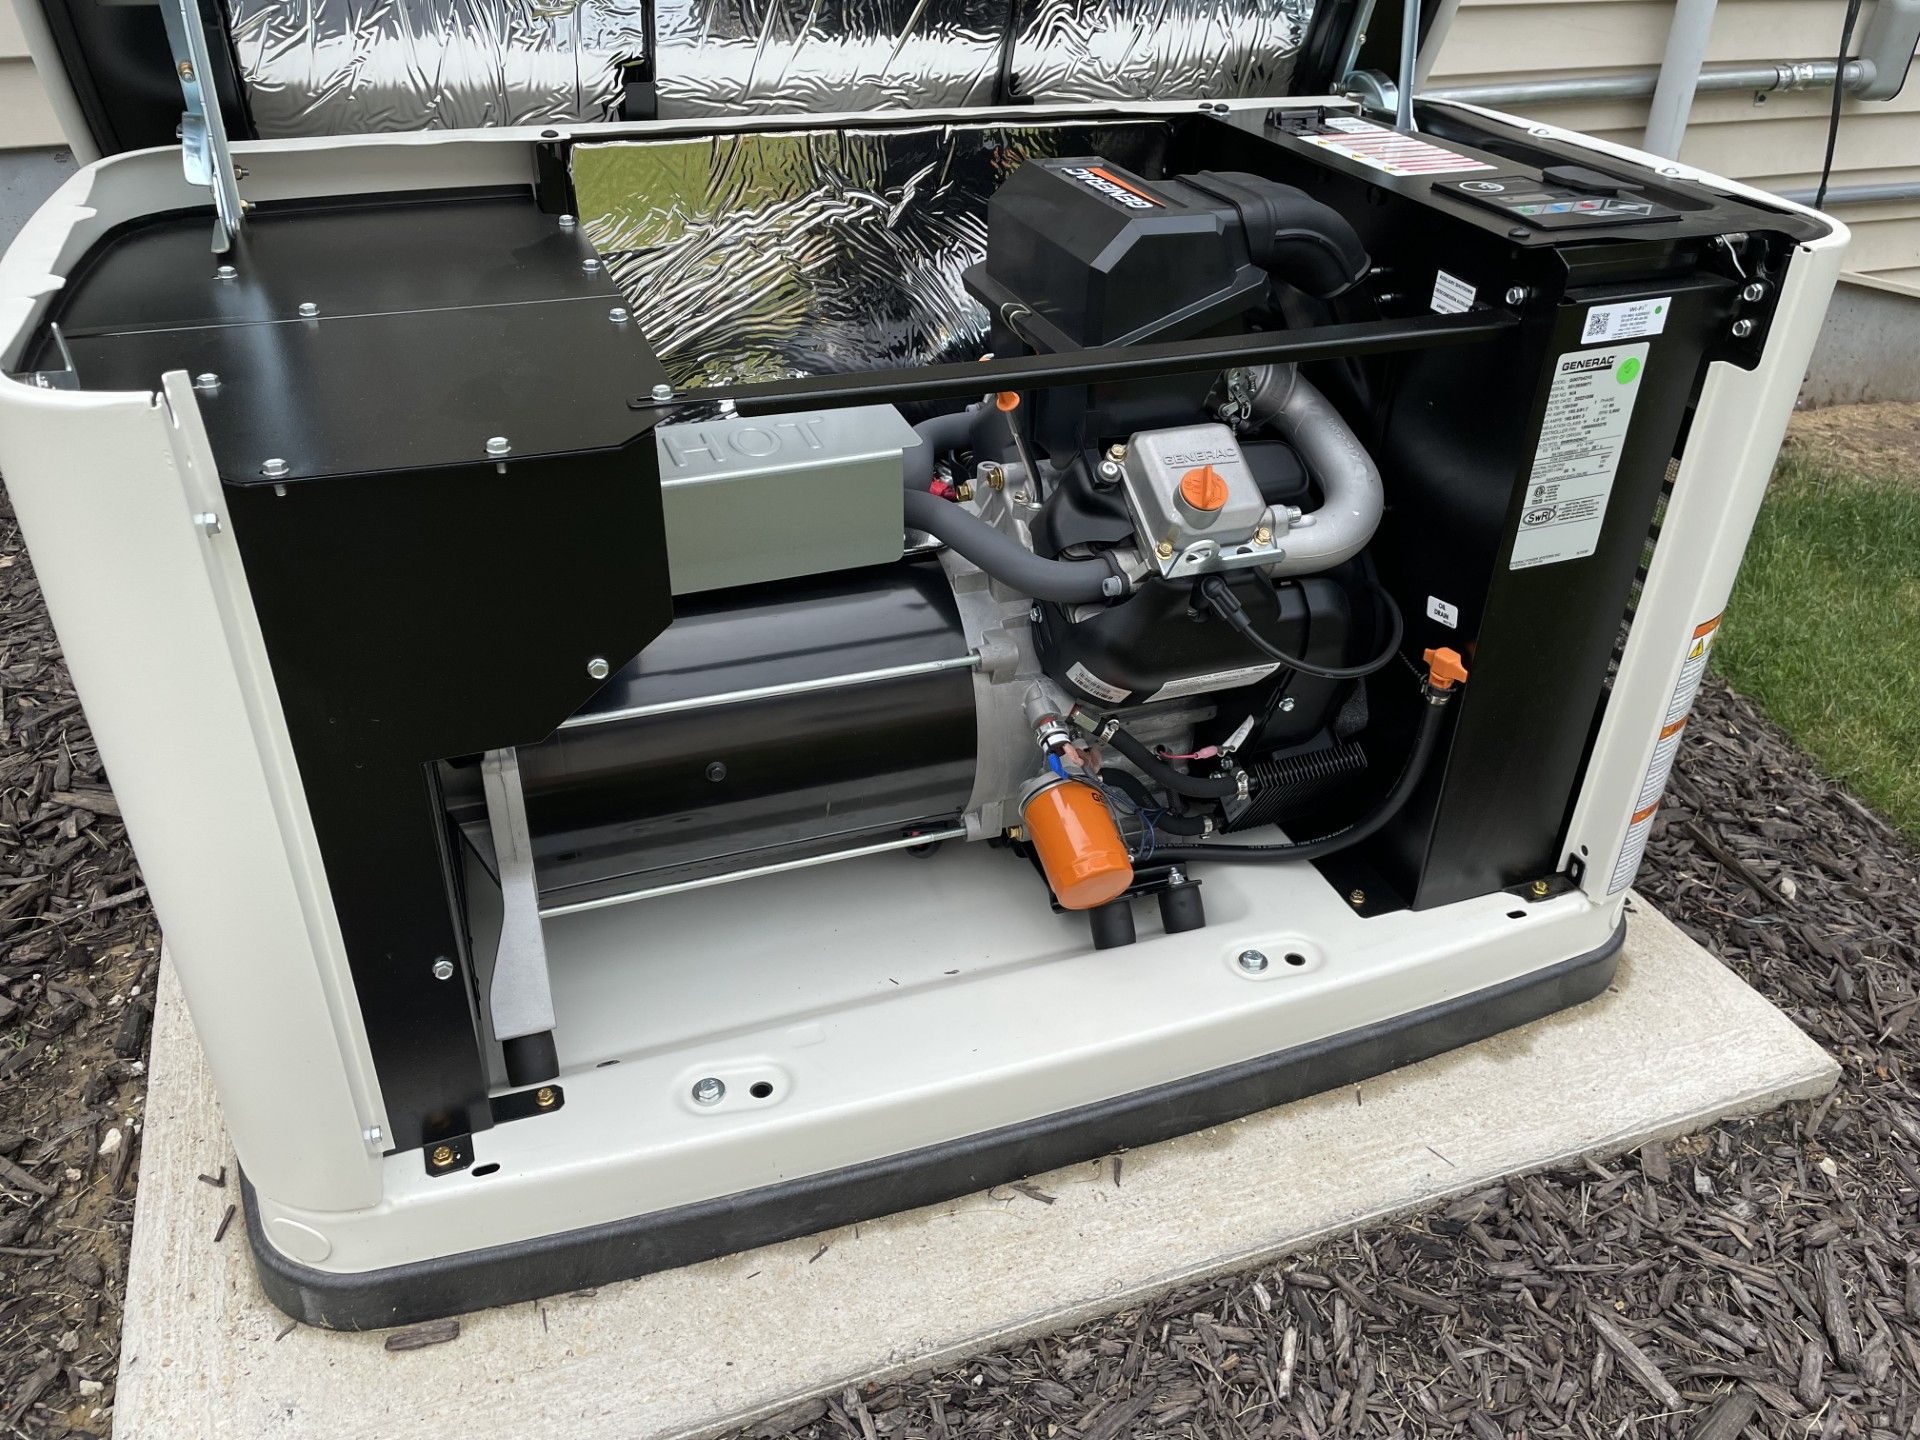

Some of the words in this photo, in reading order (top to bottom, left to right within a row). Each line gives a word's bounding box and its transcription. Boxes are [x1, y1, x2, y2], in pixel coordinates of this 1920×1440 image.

[1061, 167, 1154, 209] GENERAC
[1562, 355, 1615, 371] GENERAC
[662, 416, 824, 467] HOT
[1163, 448, 1237, 465] GENERAC
[1433, 608, 1449, 620] DRAIN
